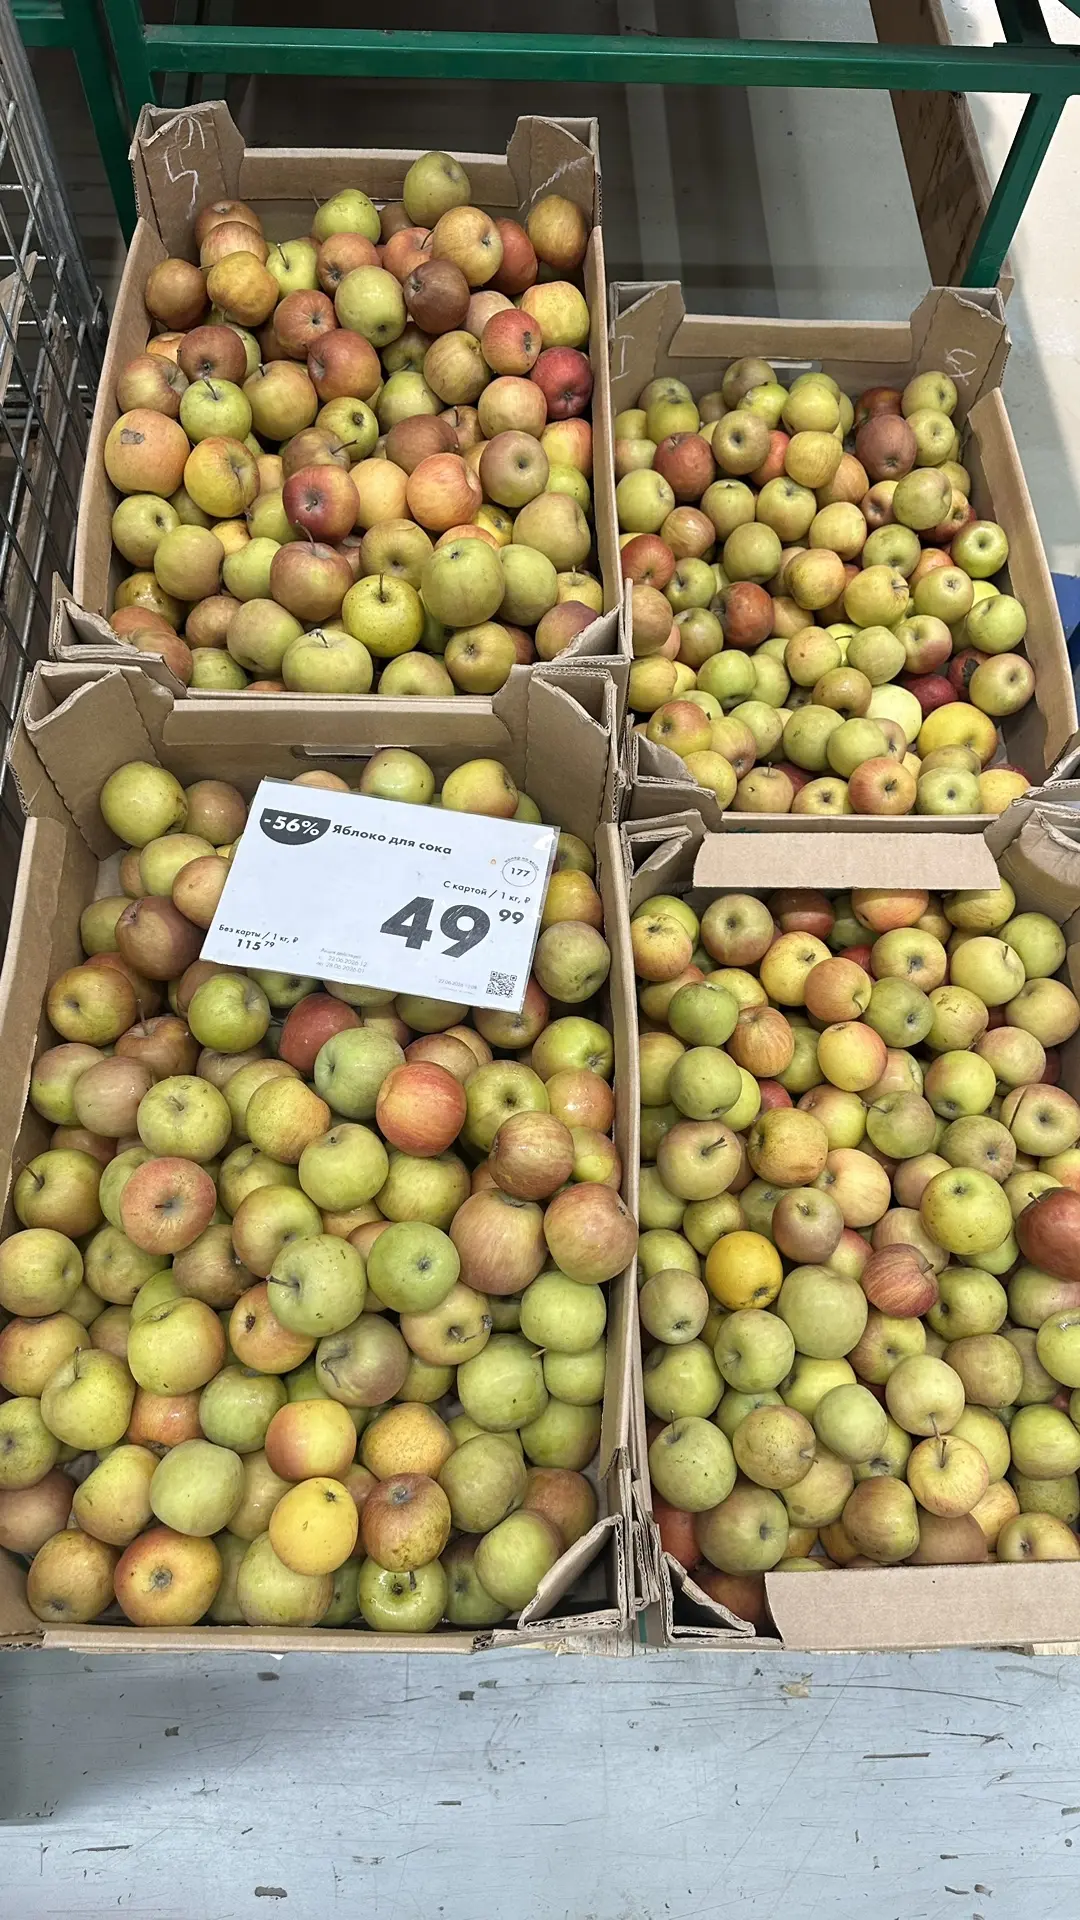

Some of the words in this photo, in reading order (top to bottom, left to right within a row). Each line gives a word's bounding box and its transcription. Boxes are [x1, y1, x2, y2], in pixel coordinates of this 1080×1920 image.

[263, 815, 320, 836] -56%
[332, 824, 387, 842] Яблоко
[388, 836, 416, 848] для
[419, 842, 452, 855] сока
[510, 867, 531, 878] 177
[443, 880, 451, 888] С
[452, 884, 487, 896] картой
[488, 889, 498, 899] /
[501, 891, 506, 900] 1
[508, 895, 521, 904] кг,
[218, 924, 234, 933] Без
[235, 928, 261, 938] карты
[261, 931, 271, 940] /
[279, 936, 290, 944] кг,
[380, 896, 491, 959] 49
[498, 908, 525, 925] 99
[237, 938, 262, 951] 115
[263, 940, 275, 948] 79
